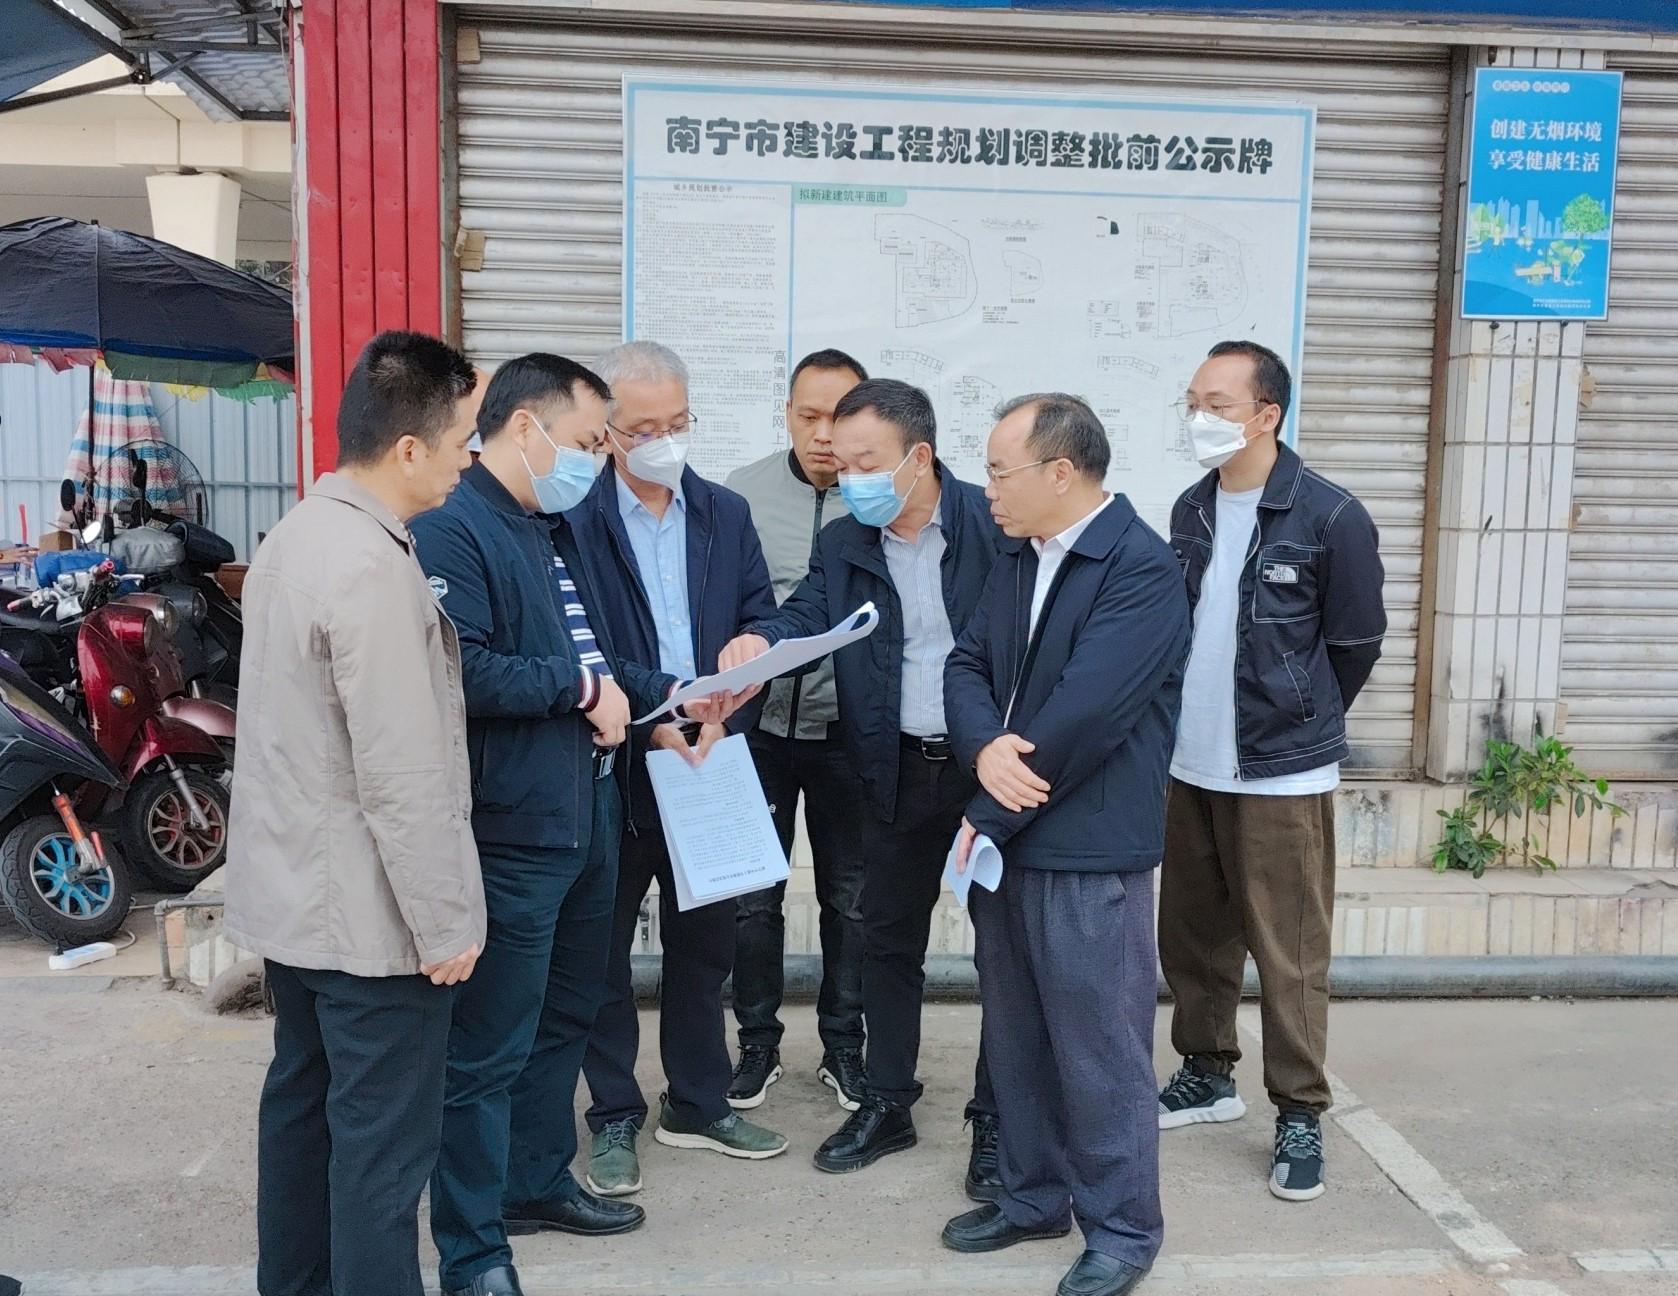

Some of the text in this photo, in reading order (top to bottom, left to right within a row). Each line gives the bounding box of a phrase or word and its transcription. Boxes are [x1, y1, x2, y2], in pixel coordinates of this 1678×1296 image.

[1491, 118, 1602, 142] 创建无烟环境
[665, 115, 1273, 175] 南宁市建设工程规划调整批前公示牌
[1489, 149, 1600, 173] 享受健康生活
[799, 188, 888, 203] 拟新建建筑平面图
[772, 350, 786, 454] 高清图见网上
